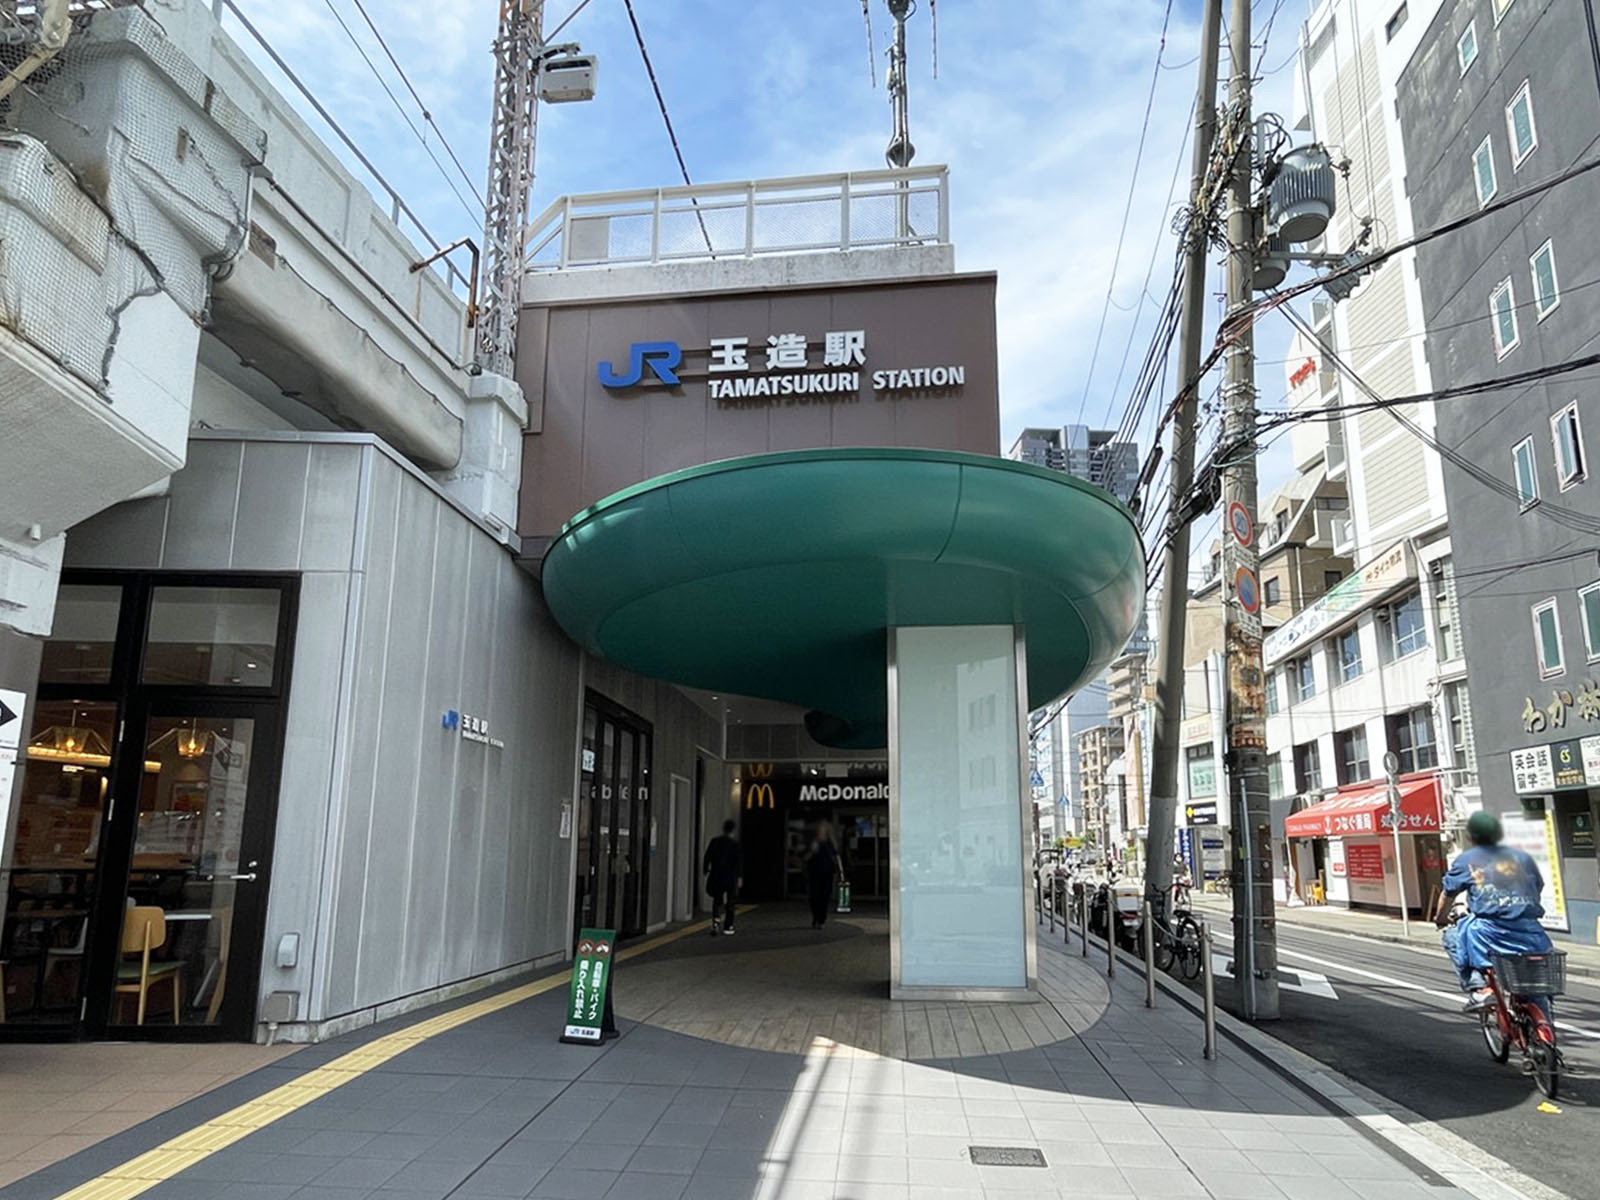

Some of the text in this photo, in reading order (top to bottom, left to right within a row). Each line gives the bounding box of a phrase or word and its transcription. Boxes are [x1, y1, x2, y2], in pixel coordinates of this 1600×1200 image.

[598, 330, 866, 388] JR 玉造駅
[708, 366, 965, 399] TAMATSUKURI STATION
